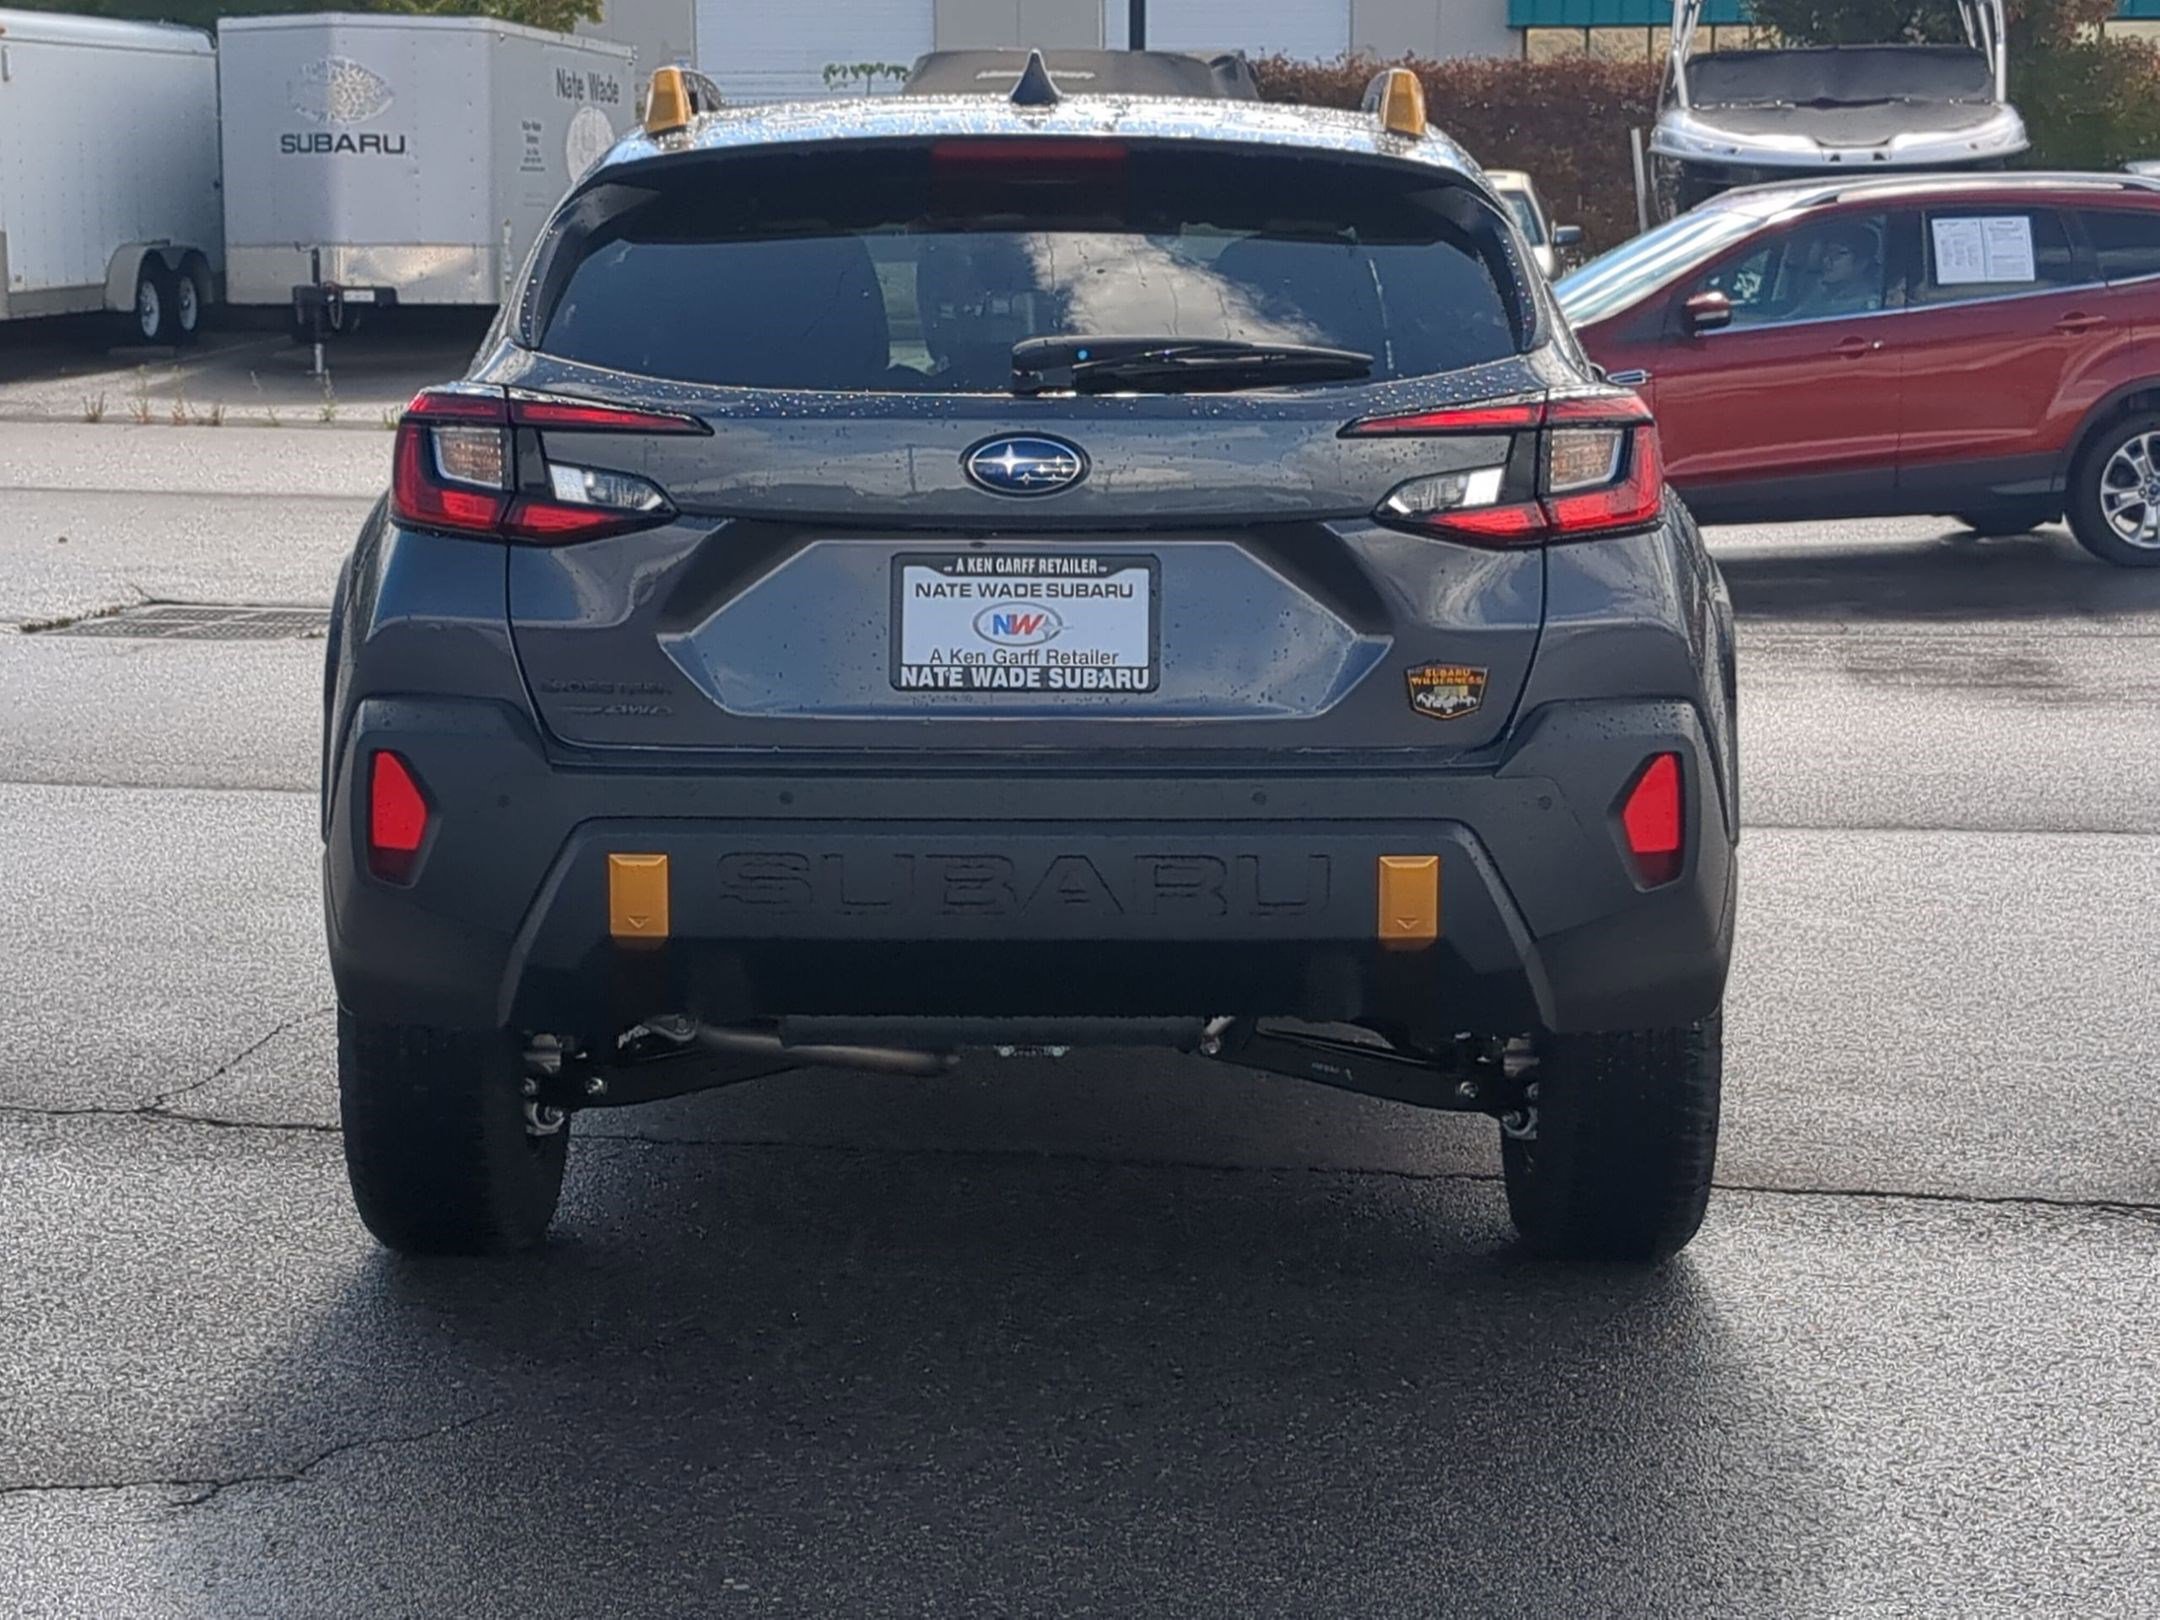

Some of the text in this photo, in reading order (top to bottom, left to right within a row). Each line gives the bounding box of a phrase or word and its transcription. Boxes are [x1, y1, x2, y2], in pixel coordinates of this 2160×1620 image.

[556, 68, 619, 104] Nate Wade
[281, 133, 405, 154] SUBARU
[956, 557, 1098, 574] A KEN GARFF RETAILER
[915, 583, 1133, 598] NATE WADE SUBARU
[992, 614, 1045, 635] NW
[930, 648, 1119, 665] A Ken Garff Retailer
[901, 666, 1149, 689] NATE WADE SUBARU
[716, 853, 1332, 915] SUBARU
